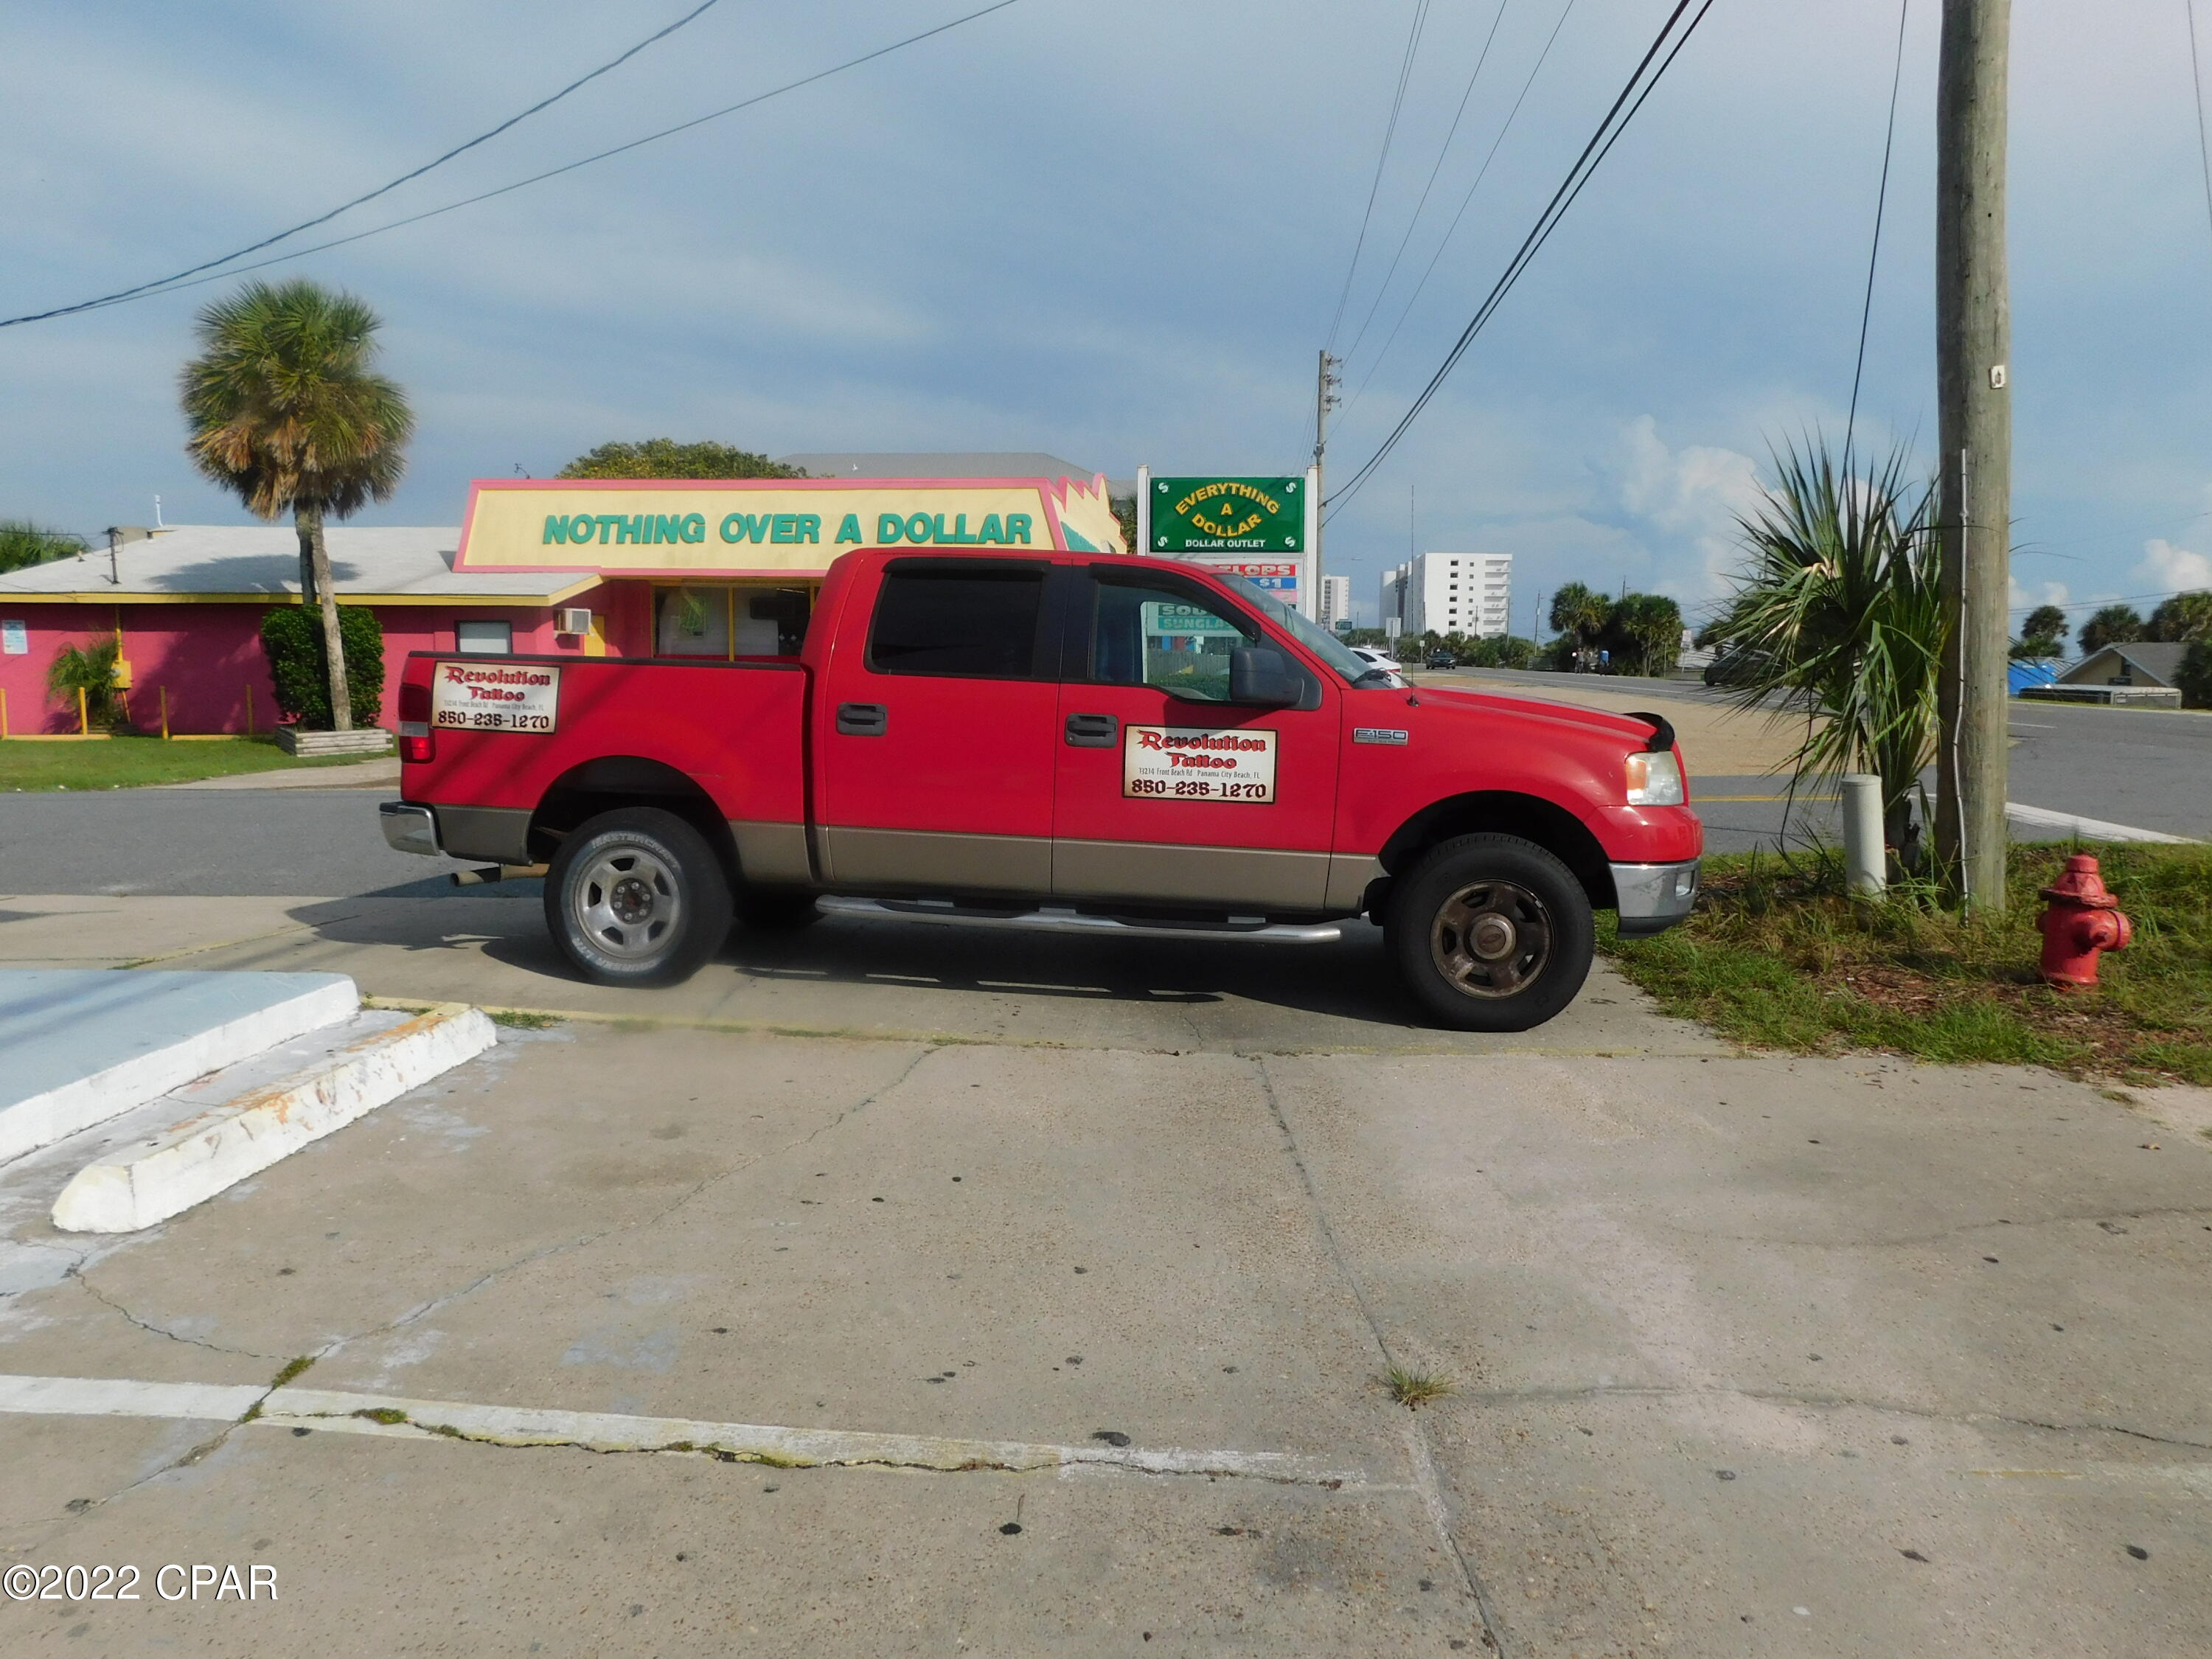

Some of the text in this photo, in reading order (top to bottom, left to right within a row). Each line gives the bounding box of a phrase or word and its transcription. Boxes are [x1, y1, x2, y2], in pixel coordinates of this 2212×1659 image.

[1175, 482, 1281, 515] EVERYTHING
[1220, 503, 1233, 515] A
[543, 512, 1032, 544] NOTHING OVER A DOLLAR
[1191, 512, 1263, 538] DOLLAR
[1185, 539, 1266, 548] DOLLAR OUTLET
[1259, 578, 1281, 588] $1
[1162, 605, 1208, 616] SOU
[1163, 618, 1231, 630] SUNGLA
[444, 666, 551, 686] Revolution
[466, 685, 525, 702] Tattoo
[438, 710, 549, 729] 850-235-1270
[1136, 729, 1267, 751] Revolution
[1355, 729, 1407, 740] F-150
[1165, 751, 1237, 769] Tattoo
[1157, 768, 1169, 776] Front
[1171, 768, 1185, 776] Beach
[1221, 771, 1232, 779] City
[1131, 779, 1267, 799] 850-235-1270
